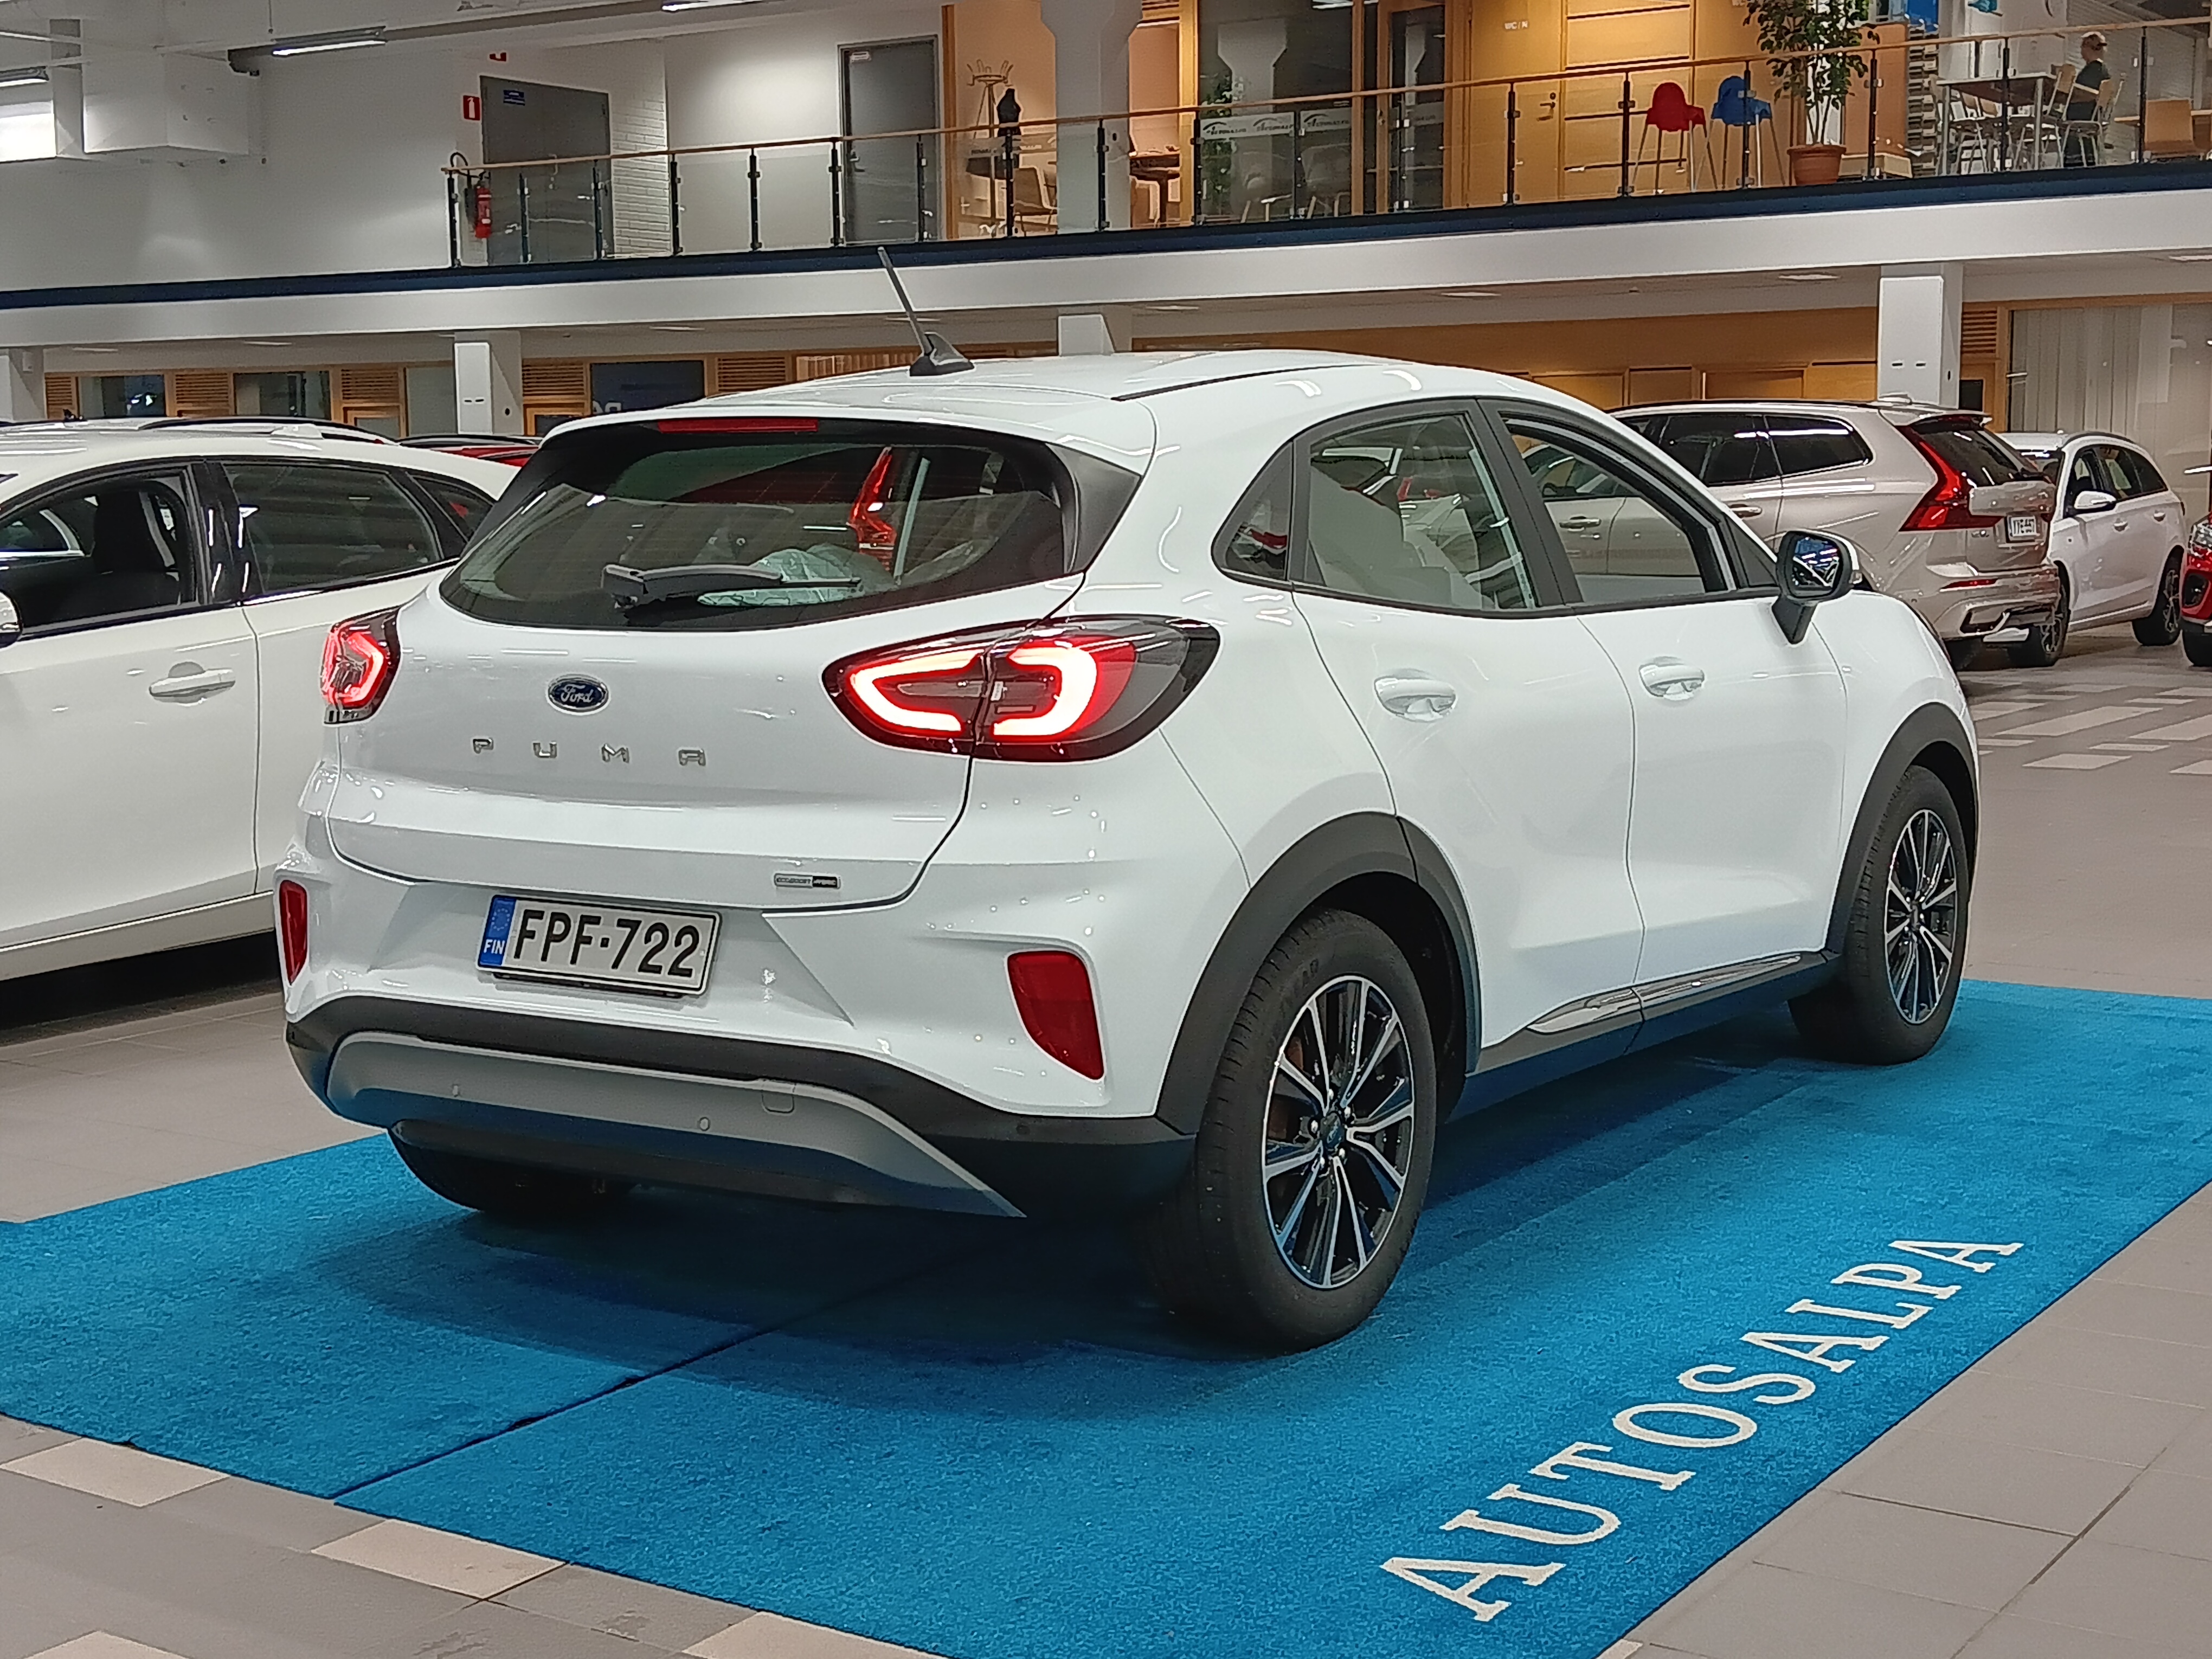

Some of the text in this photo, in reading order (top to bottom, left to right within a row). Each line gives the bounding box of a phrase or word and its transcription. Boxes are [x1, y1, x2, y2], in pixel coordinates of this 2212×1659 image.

[561, 684, 594, 703] Ford
[473, 738, 705, 766] PUMA
[484, 939, 505, 955] FIN
[1380, 1239, 2024, 1622] AUTOSALPA
